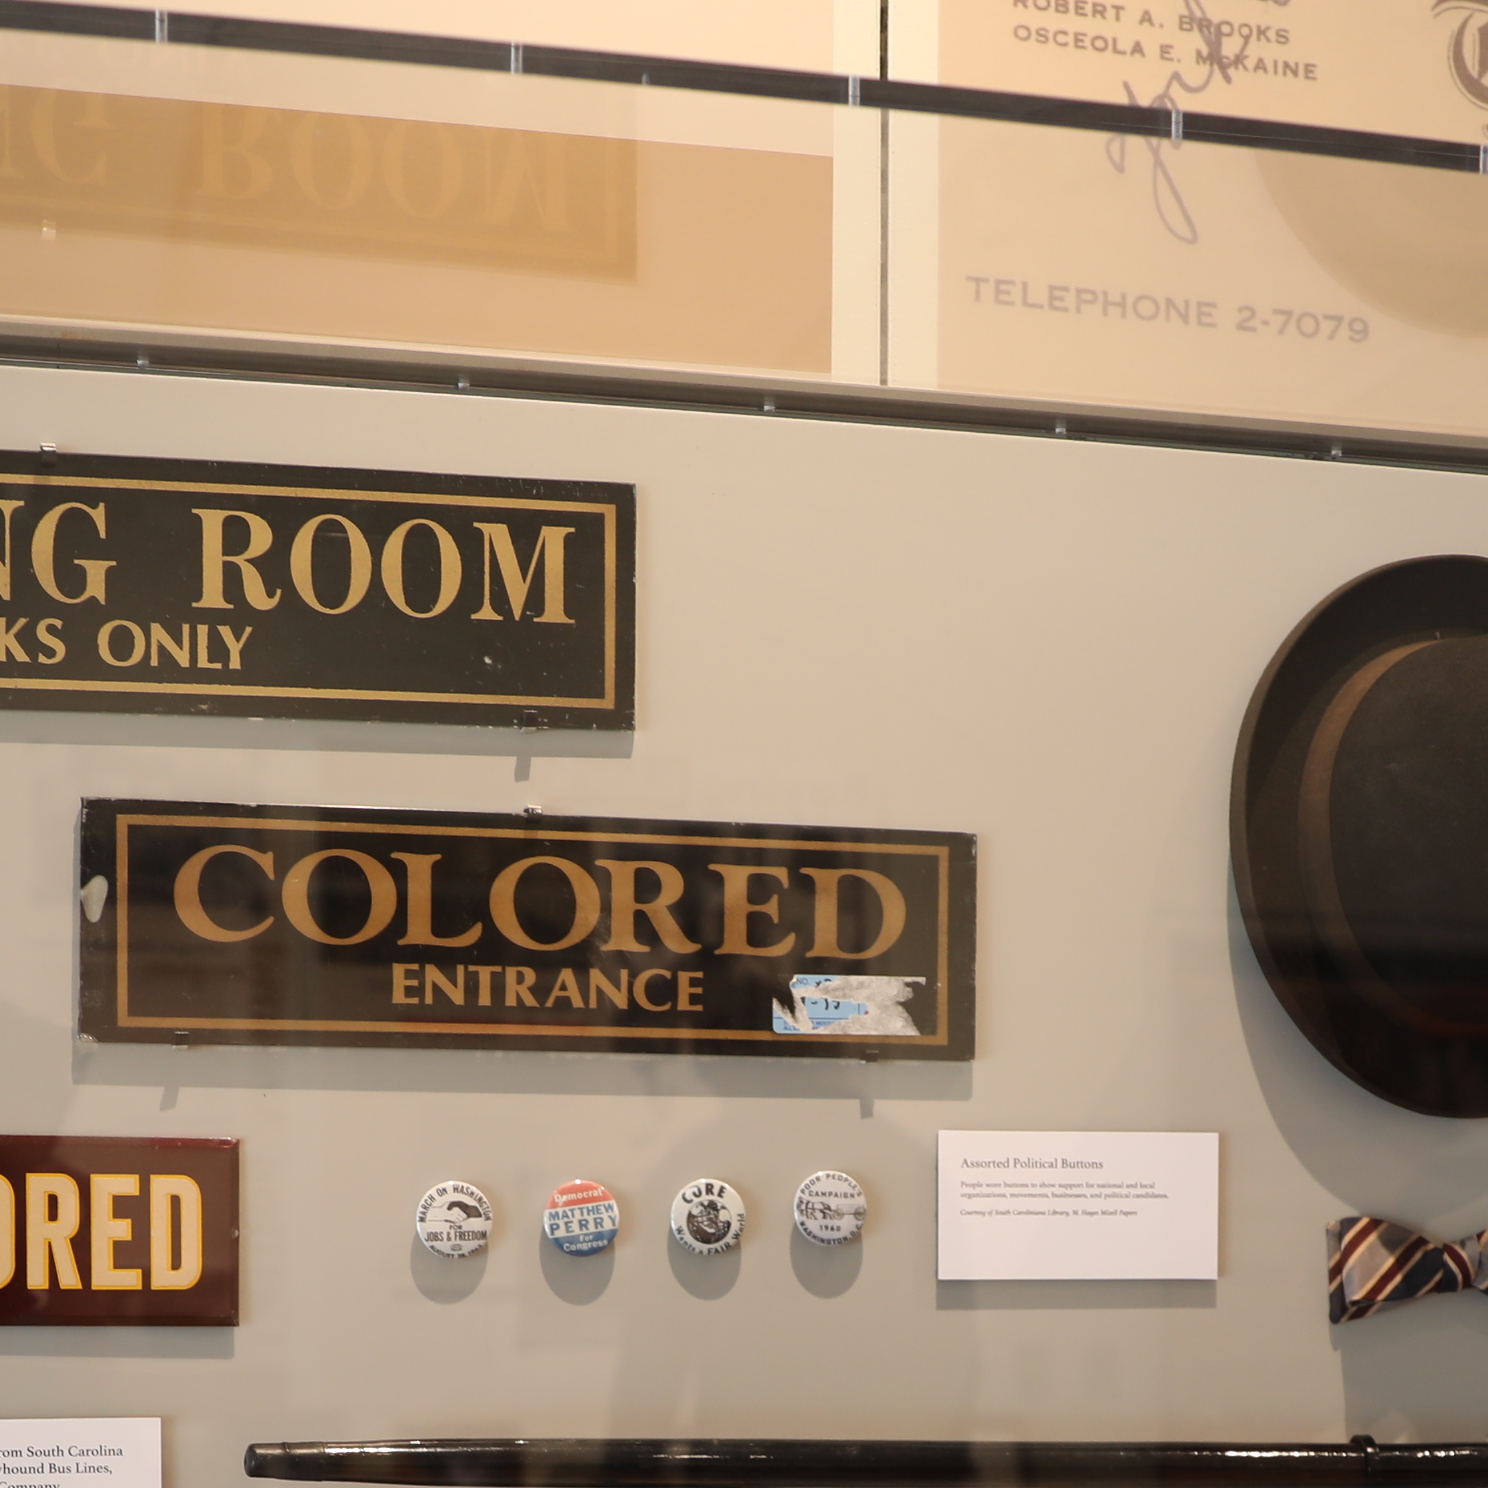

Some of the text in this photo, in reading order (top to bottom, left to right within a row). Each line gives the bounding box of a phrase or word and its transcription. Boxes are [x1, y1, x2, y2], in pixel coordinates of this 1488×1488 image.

[1012, 24, 1145, 59] OSCEOLA
[1179, 14, 1291, 45] BROOKS
[966, 275, 1370, 345] TELEPHONE 2-7079
[192, 508, 575, 625] ROOM
[98, 620, 253, 671] ONLY
[173, 843, 907, 960] COLORED
[391, 963, 704, 1012] ENTRANCE
[961, 1157, 1104, 1170] Assorted Political Buttons
[549, 1203, 614, 1221] MATTHEW
[454, 1230, 487, 1242] FREEDOM
[550, 1215, 618, 1236] PERRY
[563, 1239, 608, 1252] Congress
[26, 1446, 64, 1458] South
[67, 1445, 123, 1457] Carolina
[48, 1462, 72, 1475] Bus
[75, 1462, 113, 1476] Lines,
